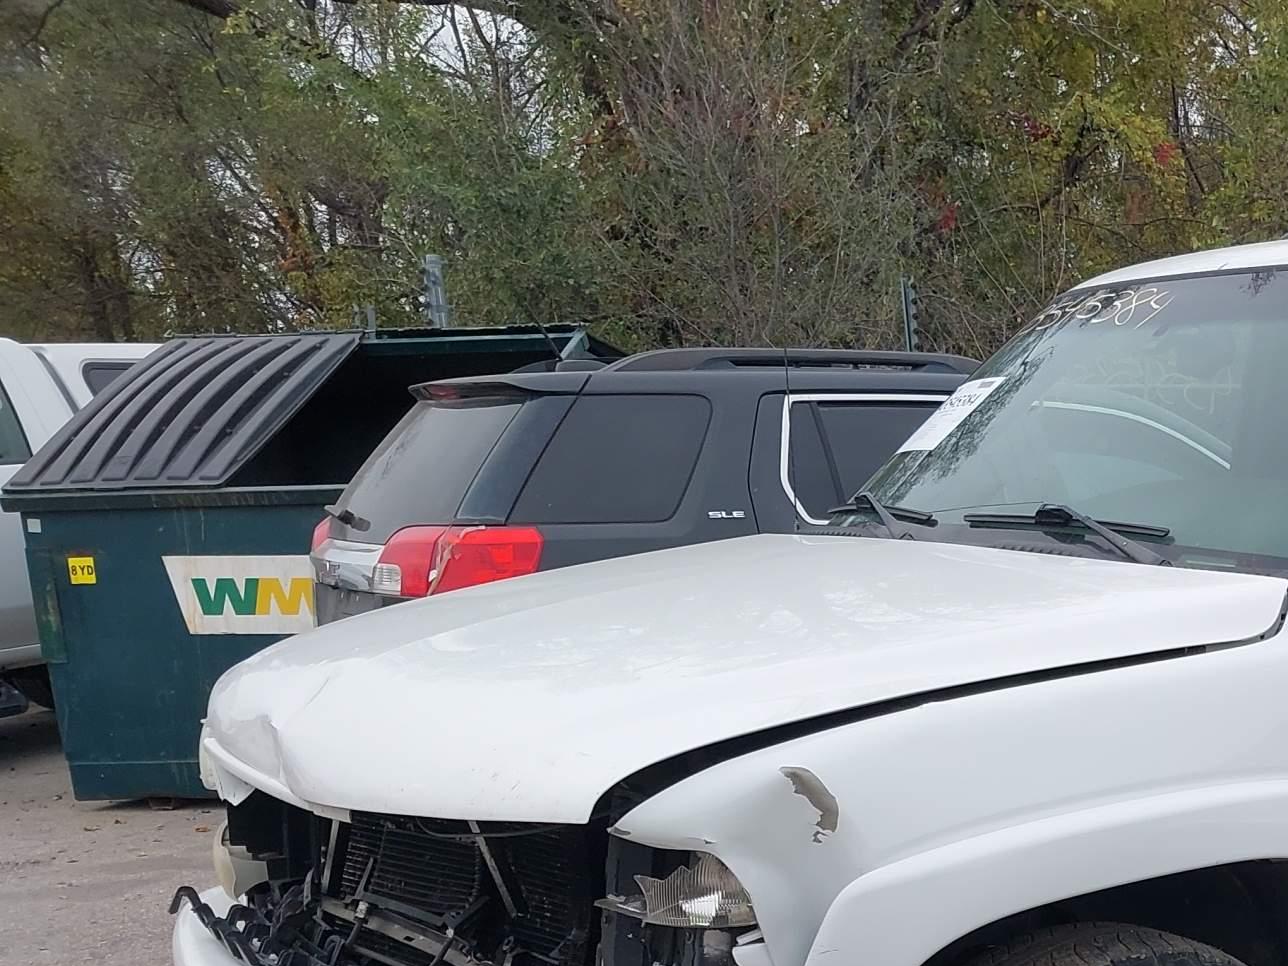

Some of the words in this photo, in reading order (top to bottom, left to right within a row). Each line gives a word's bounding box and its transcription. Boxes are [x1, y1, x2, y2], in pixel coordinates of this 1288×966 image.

[708, 510, 746, 519] SLE
[71, 565, 78, 576] 8
[78, 565, 94, 576] YD
[191, 578, 314, 616] WM
